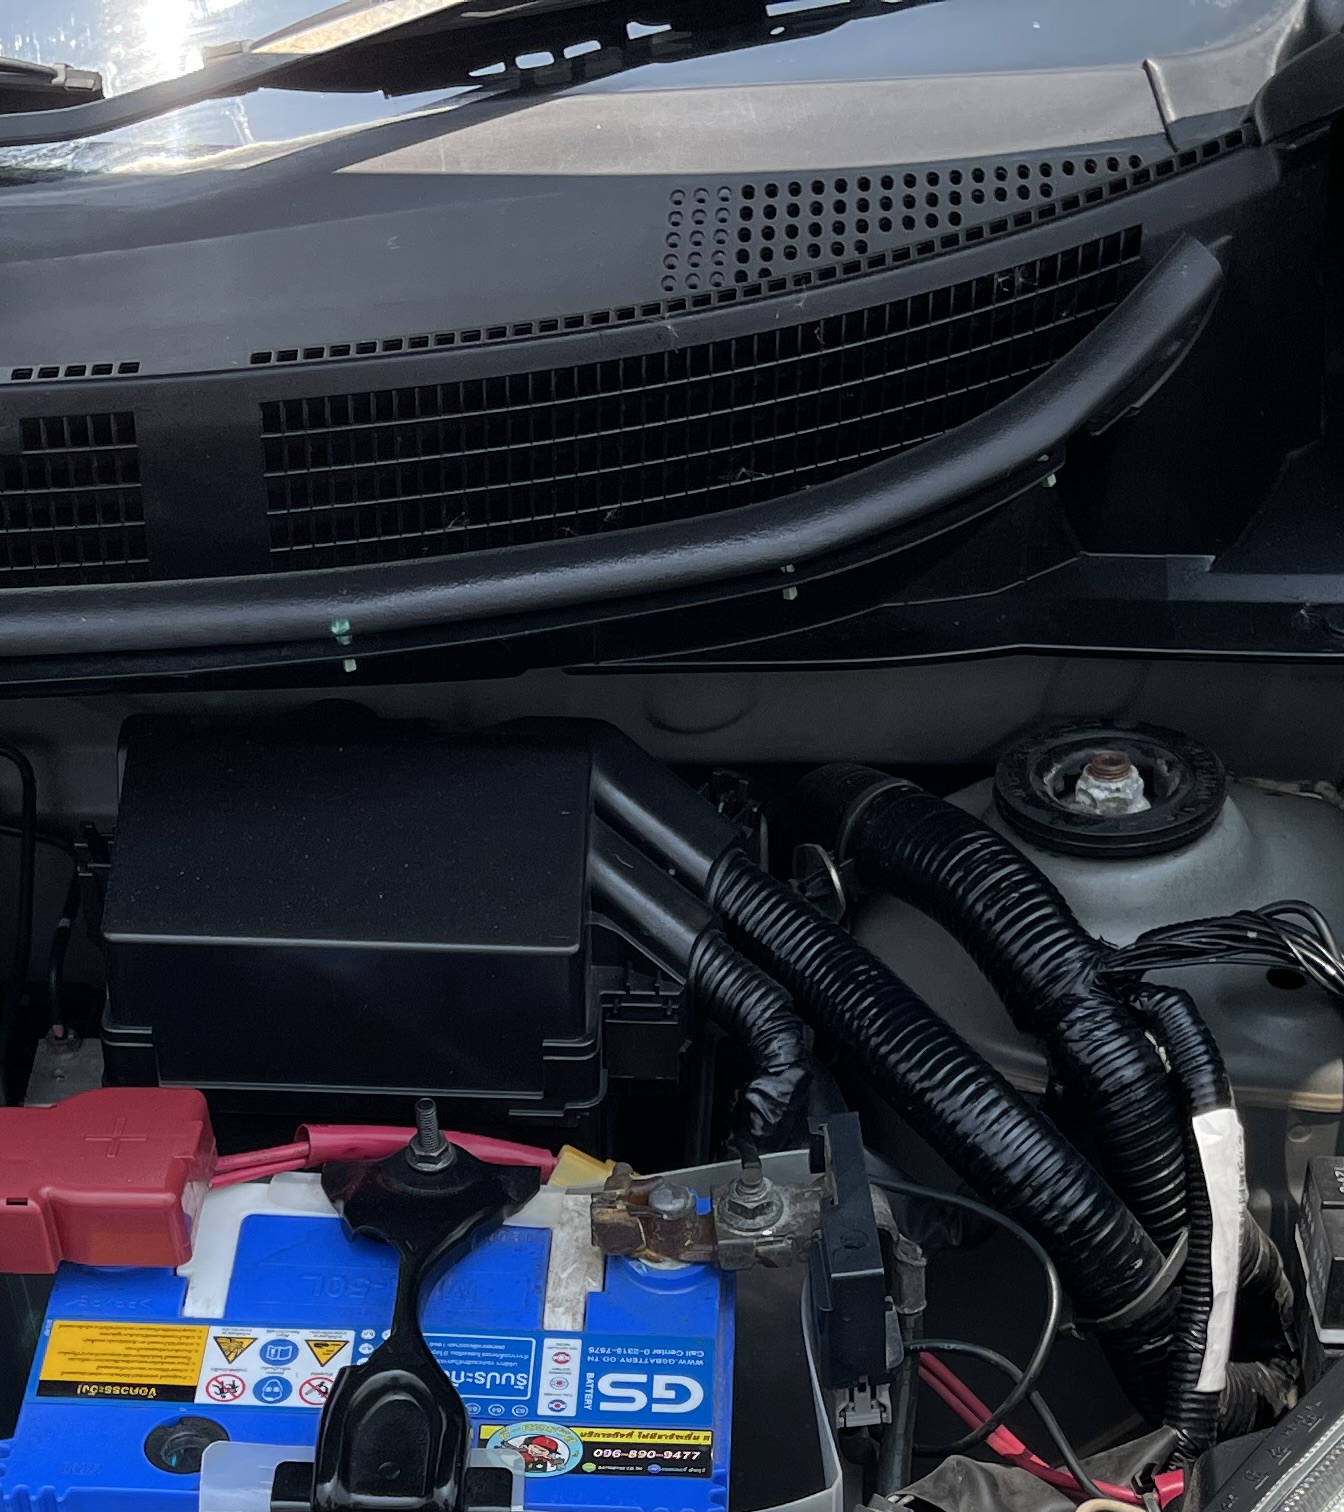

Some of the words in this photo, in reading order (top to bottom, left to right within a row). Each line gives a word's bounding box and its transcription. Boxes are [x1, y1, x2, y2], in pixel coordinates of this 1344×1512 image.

[583, 1372, 595, 1411] BATTERY
[598, 1372, 704, 1414] GS
[592, 1448, 701, 1461] 096-890-9477
